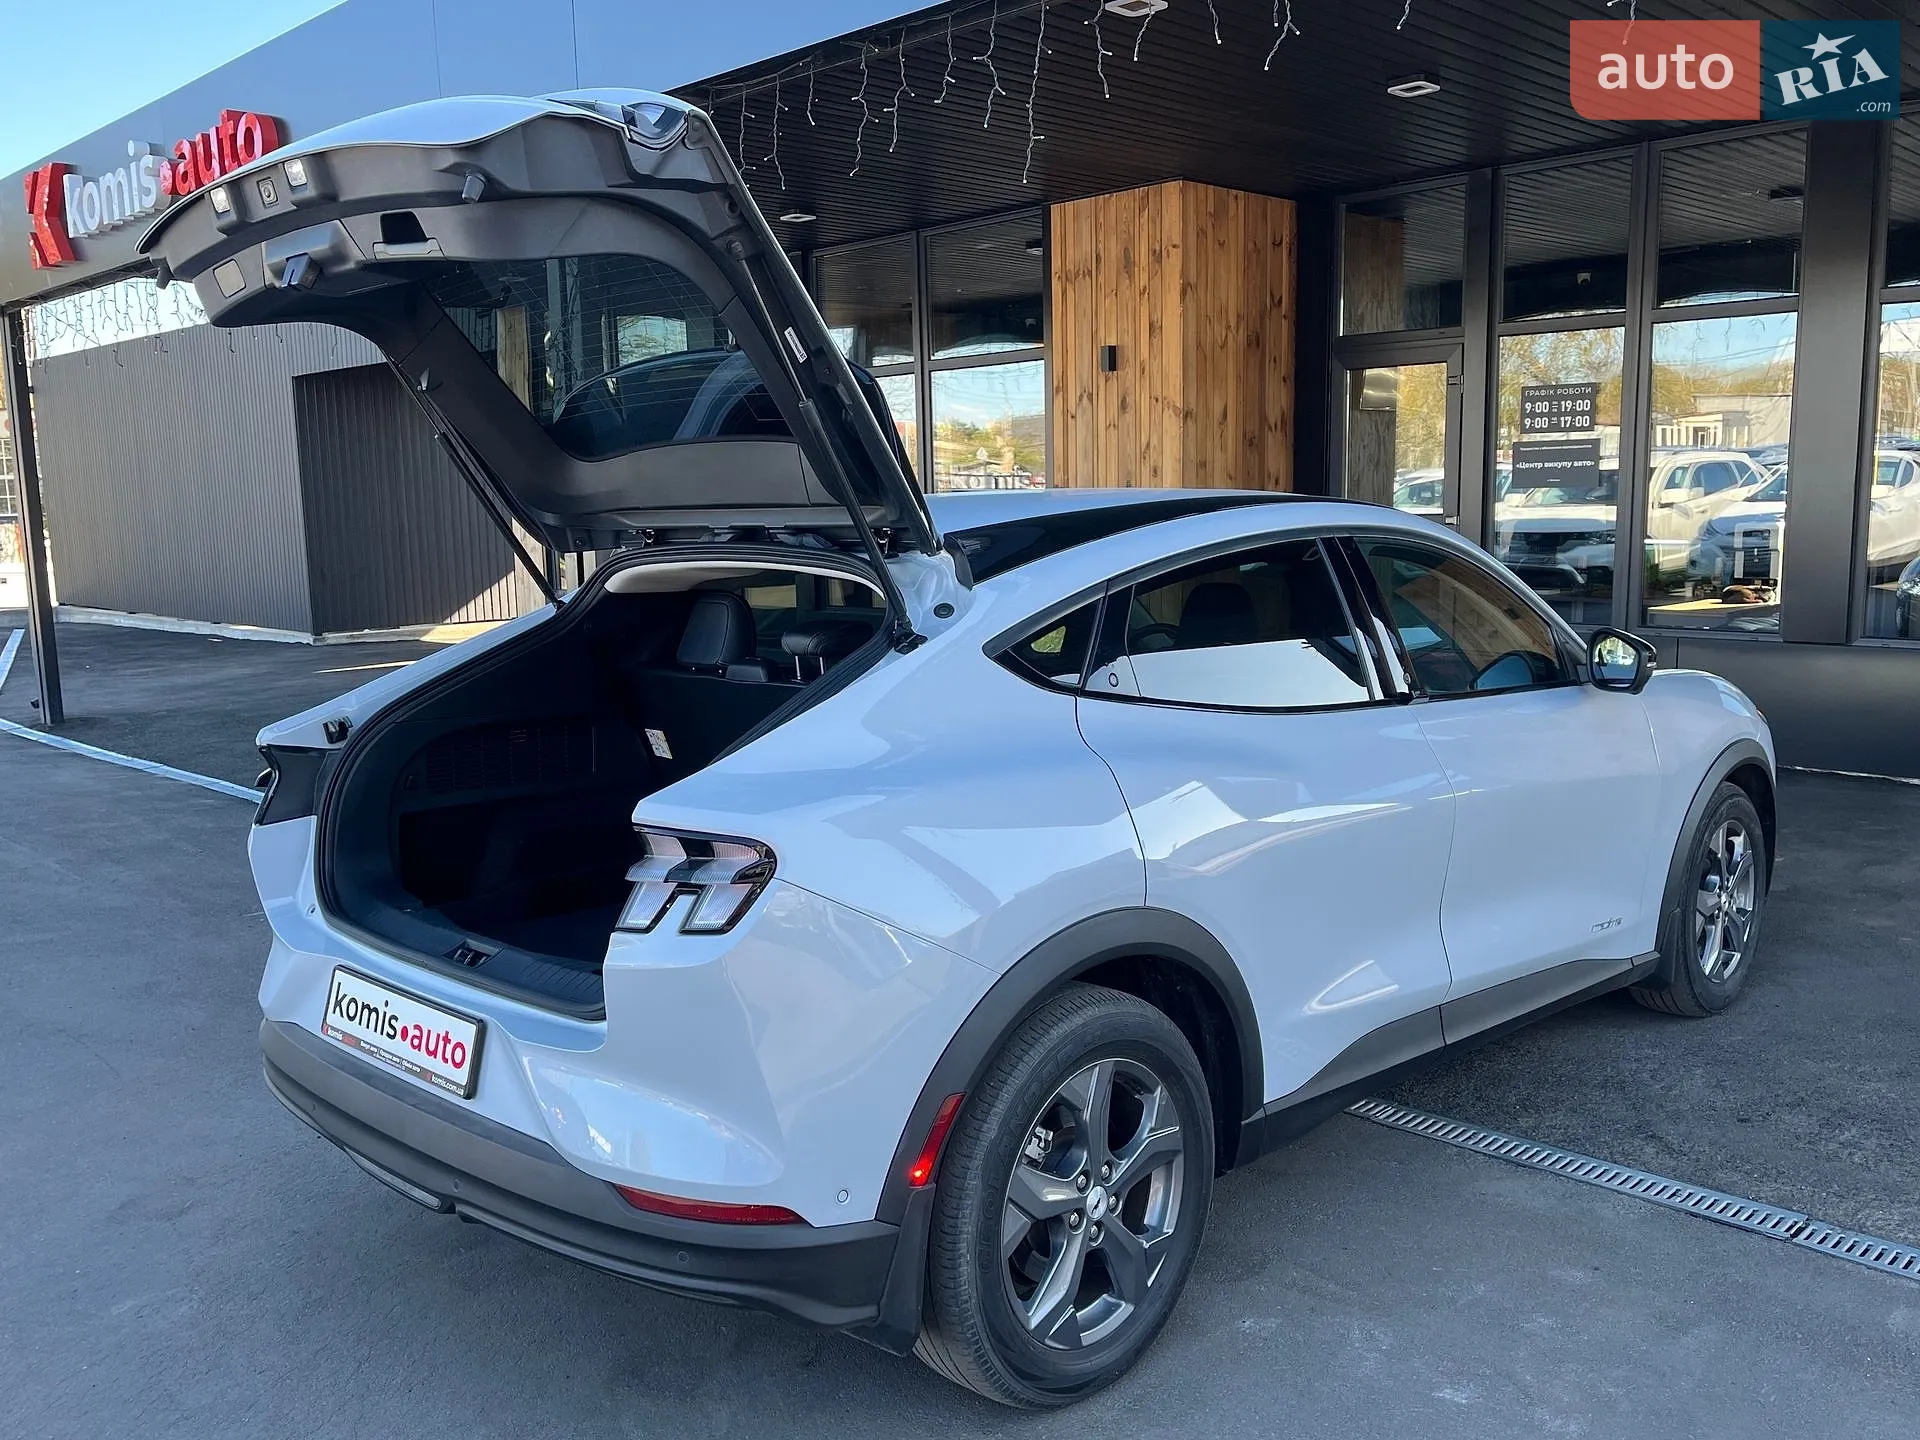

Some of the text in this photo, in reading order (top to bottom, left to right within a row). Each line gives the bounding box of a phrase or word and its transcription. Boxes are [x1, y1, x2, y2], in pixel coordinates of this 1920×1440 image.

[1525, 387, 1592, 397] ГРАФІК РОБОТИ
[1525, 401, 1549, 413] 9:00
[1561, 399, 1591, 412] 19:00
[1524, 417, 1549, 429] 9:00
[1560, 415, 1590, 428] 17:00
